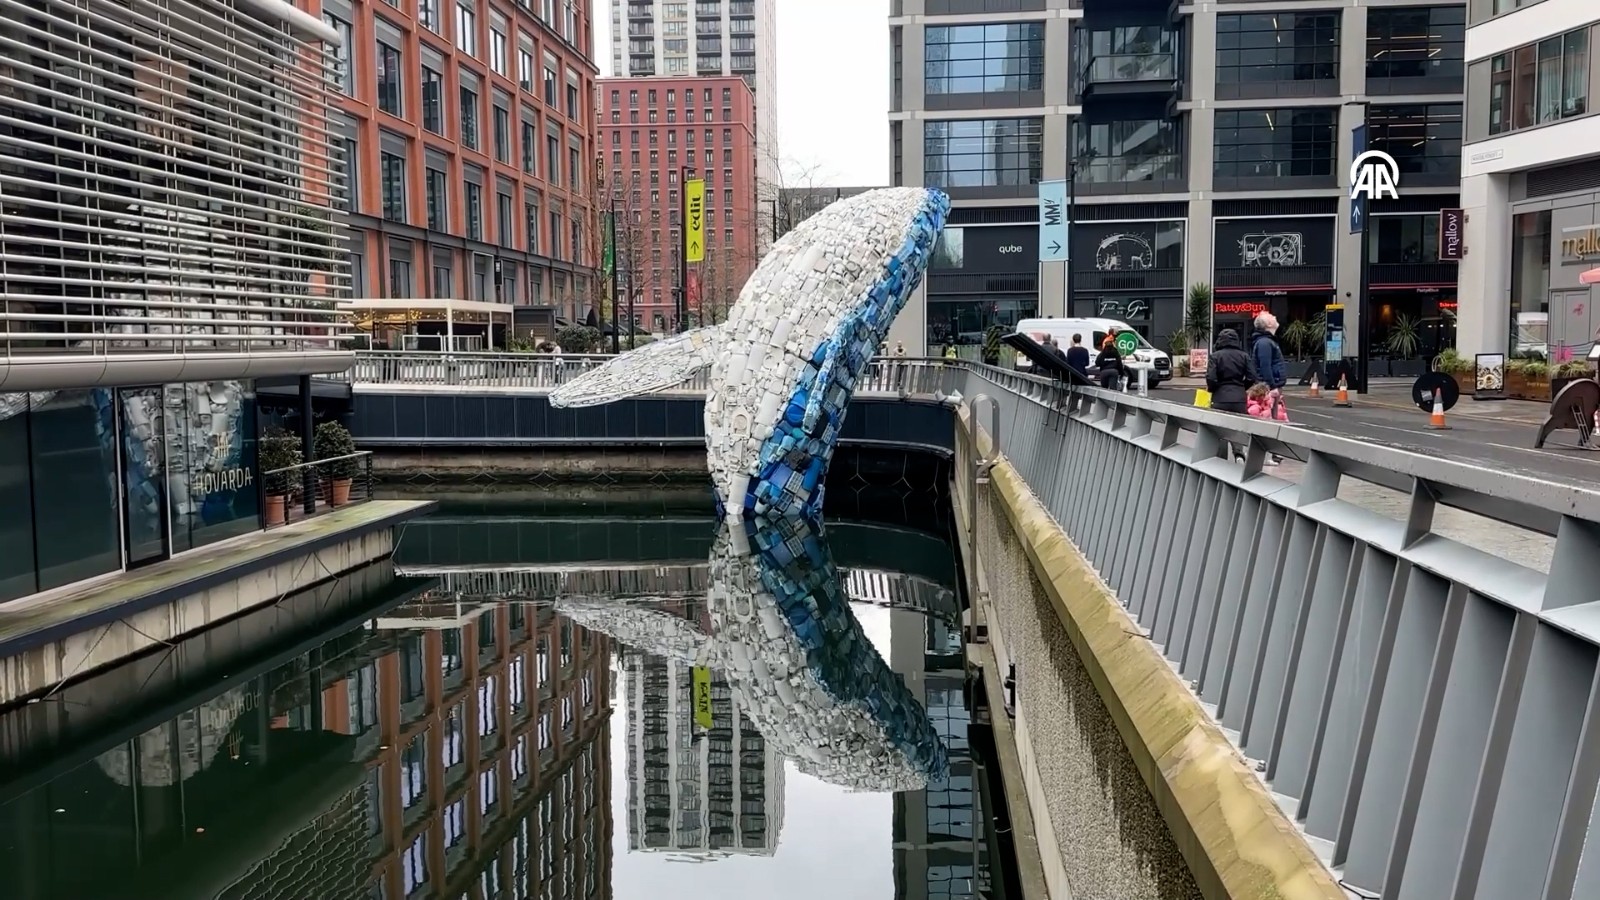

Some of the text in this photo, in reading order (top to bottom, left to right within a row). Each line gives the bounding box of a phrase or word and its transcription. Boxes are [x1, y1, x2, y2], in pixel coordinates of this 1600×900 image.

[690, 196, 701, 231] edit
[998, 244, 1023, 253] qube
[1446, 213, 1459, 256] mallow
[1118, 339, 1135, 350] GO
[193, 466, 253, 496] HOVARDA
